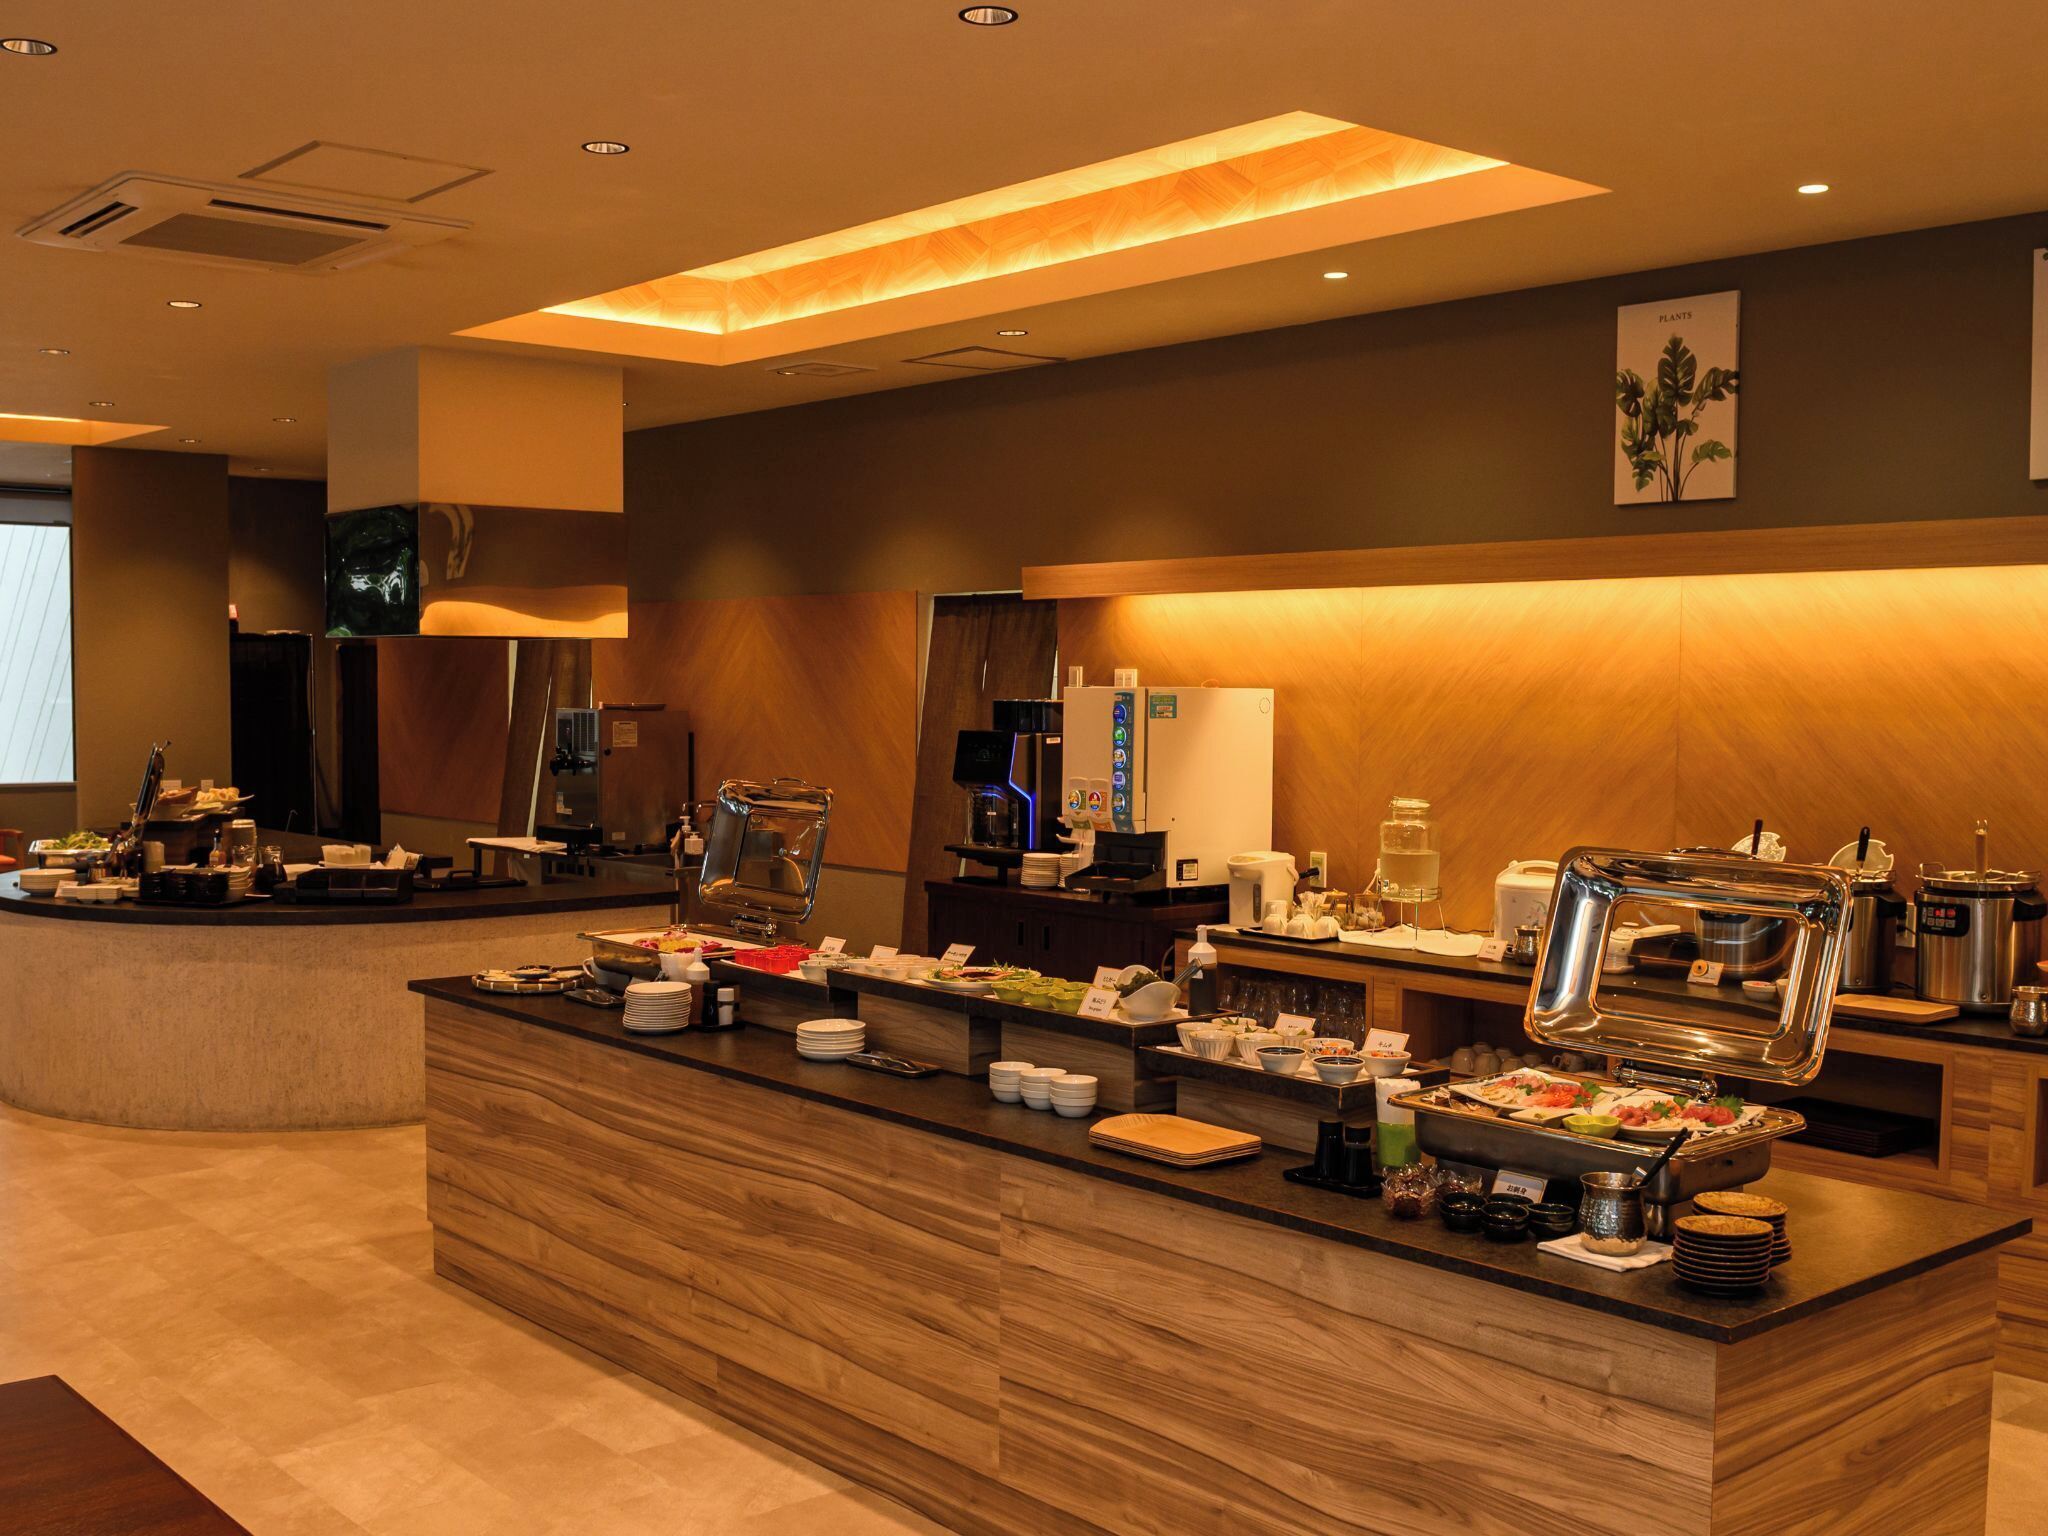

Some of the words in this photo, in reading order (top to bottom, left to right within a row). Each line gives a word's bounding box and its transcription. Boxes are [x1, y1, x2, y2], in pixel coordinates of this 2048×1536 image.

[1659, 311, 1693, 323] PLANTS
[1506, 1184, 1527, 1195] お刺身
